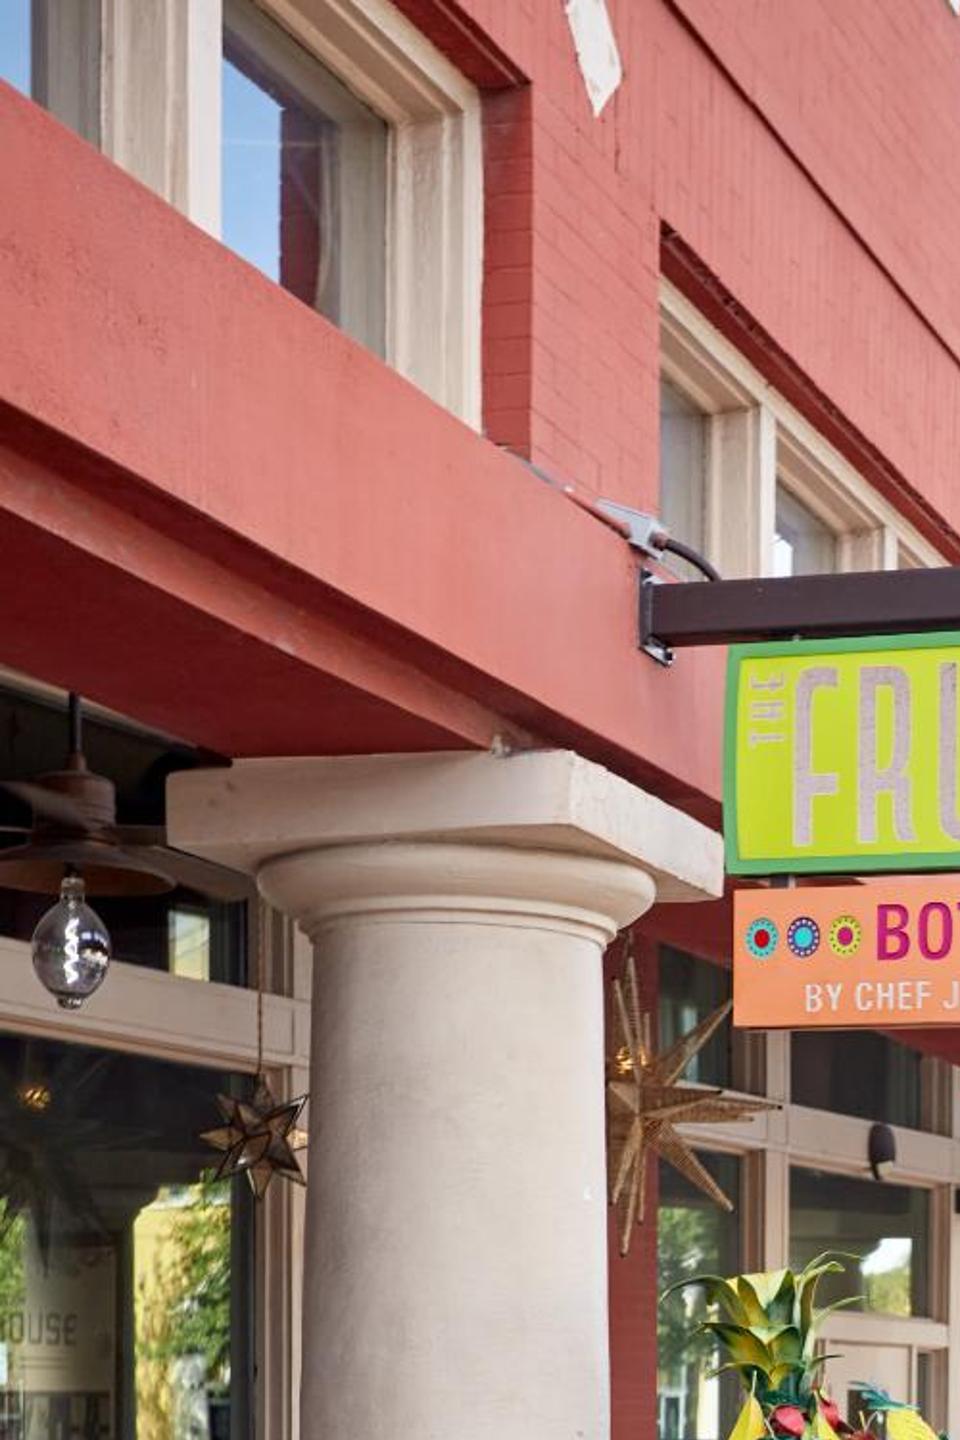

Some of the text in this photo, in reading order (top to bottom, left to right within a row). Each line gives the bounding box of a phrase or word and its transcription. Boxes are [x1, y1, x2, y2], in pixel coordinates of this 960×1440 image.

[748, 669, 785, 748] THE
[805, 983, 843, 1013] BY
[854, 977, 932, 1012] CHEF
[0, 1311, 77, 1347] OUSE
